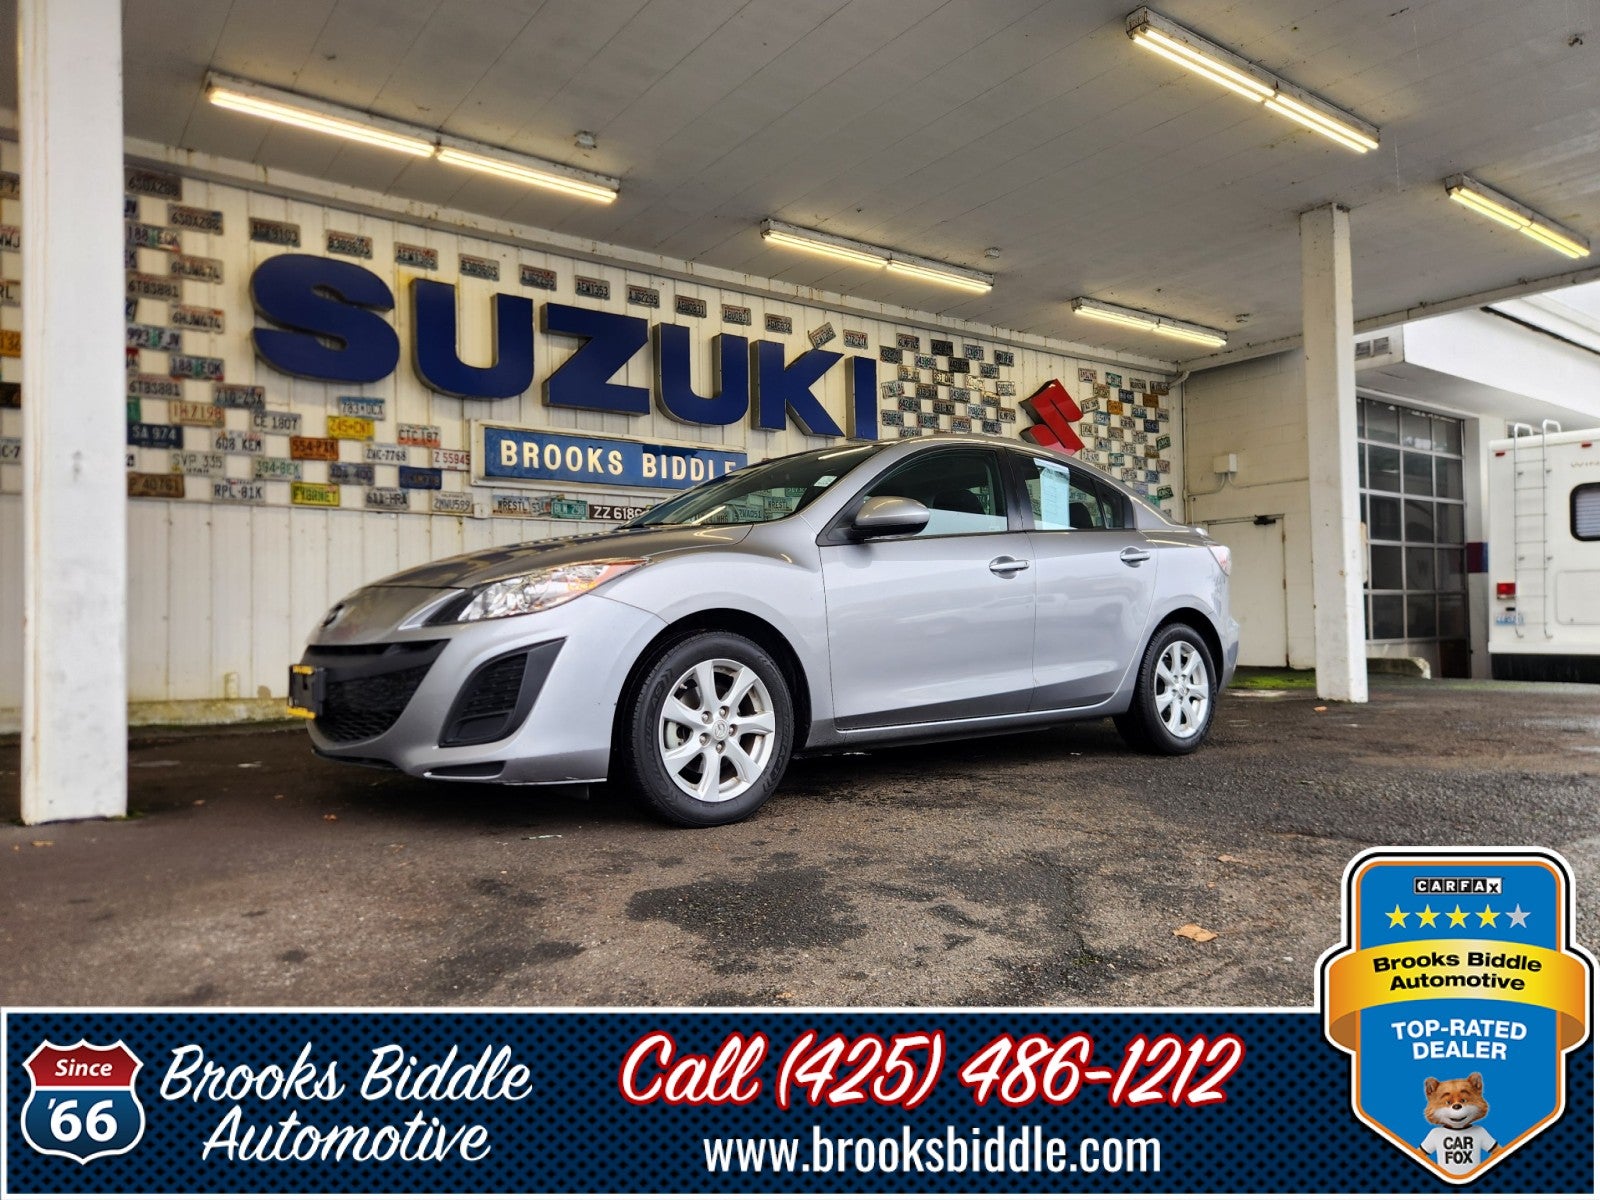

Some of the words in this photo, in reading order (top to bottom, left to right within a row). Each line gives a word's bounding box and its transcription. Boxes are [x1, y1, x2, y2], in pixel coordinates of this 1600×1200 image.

[251, 253, 876, 440] SUZUKI
[500, 439, 623, 476] BROOKS
[593, 506, 611, 519] ZZ
